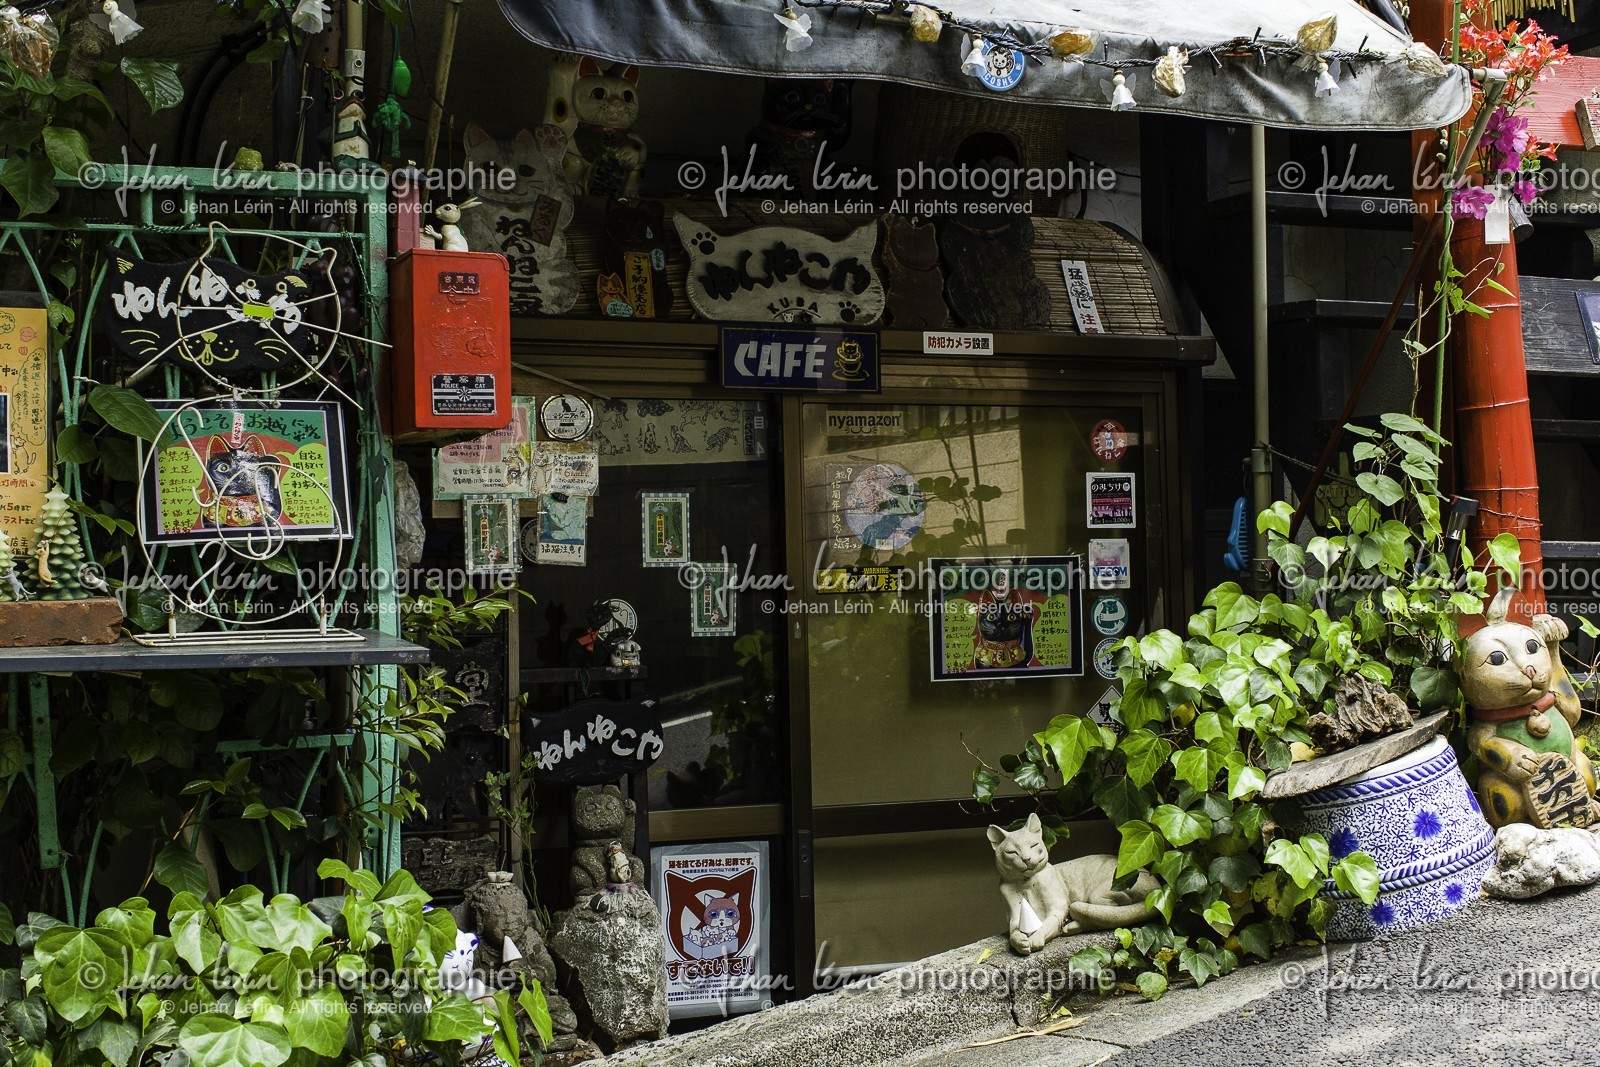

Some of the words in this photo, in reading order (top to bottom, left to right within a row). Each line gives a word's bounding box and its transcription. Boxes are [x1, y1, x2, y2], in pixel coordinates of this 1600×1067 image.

[985, 73, 1014, 87] COSHE
[698, 241, 871, 301] ねんねこや
[927, 336, 990, 350] 防犯カメラ設置
[734, 338, 827, 378] CAFÉ
[829, 413, 902, 429] nyamazon
[533, 714, 664, 771] ねんねこや
[665, 956, 756, 980] すてないで!!
